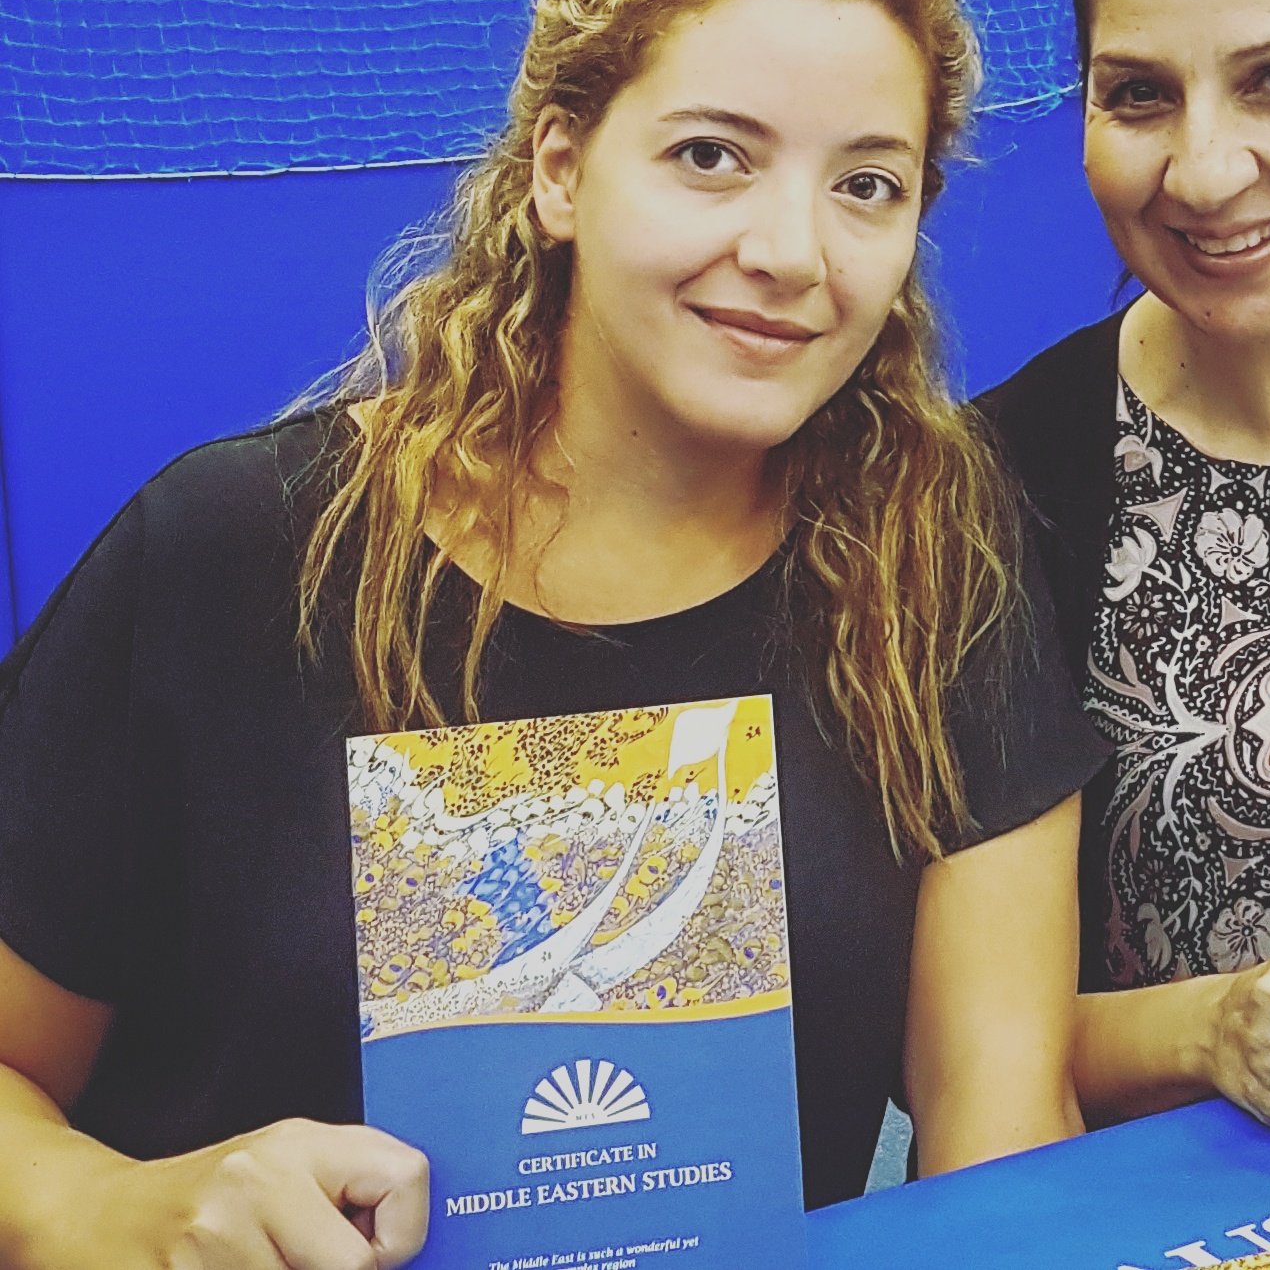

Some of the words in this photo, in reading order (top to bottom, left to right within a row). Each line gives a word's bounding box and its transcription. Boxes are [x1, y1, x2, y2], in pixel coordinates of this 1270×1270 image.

[518, 1145, 635, 1175] CERTIFICATE
[637, 1142, 657, 1159] IN
[446, 1186, 532, 1217] MIDDLE
[537, 1173, 636, 1205] EASTERN
[642, 1160, 732, 1191] STUDIES
[512, 1256, 550, 1270] Middle
[552, 1253, 574, 1266] East
[577, 1250, 586, 1262] is
[589, 1247, 613, 1260] such
[616, 1248, 623, 1257] a
[626, 1237, 681, 1255] wonderful
[682, 1235, 699, 1250] yet
